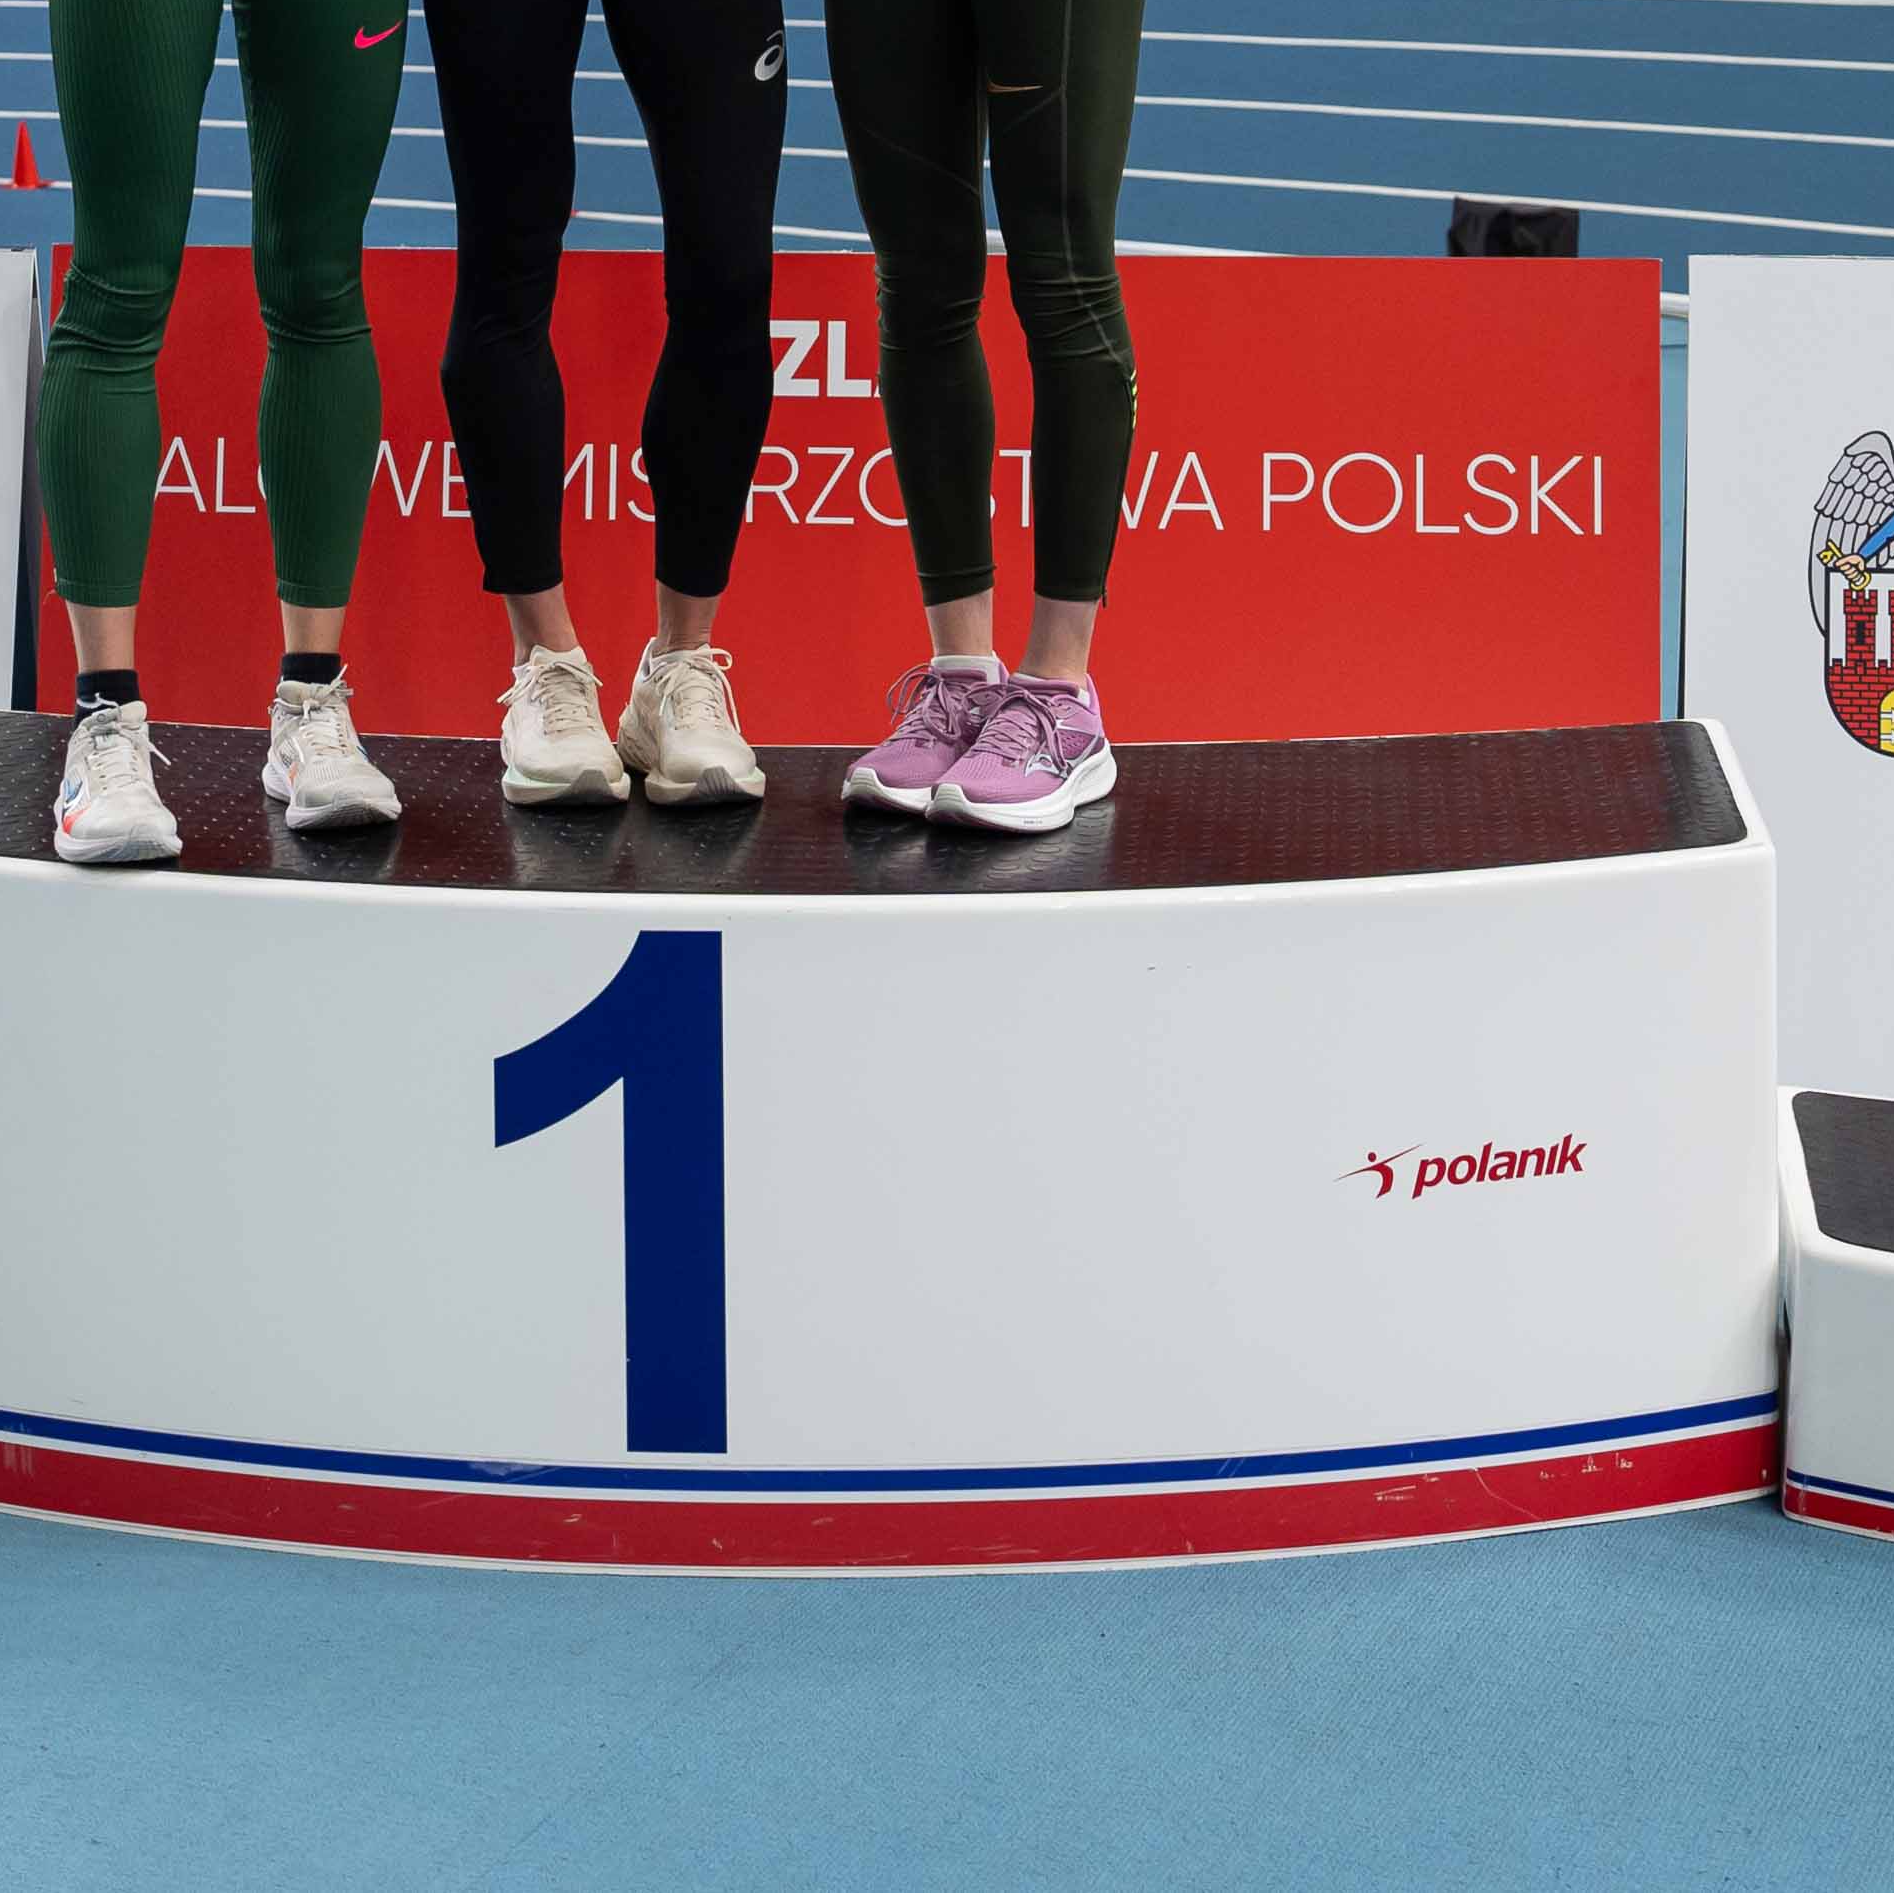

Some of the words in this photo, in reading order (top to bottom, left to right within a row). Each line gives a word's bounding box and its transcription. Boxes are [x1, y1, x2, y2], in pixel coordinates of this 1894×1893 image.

[771, 319, 882, 399] ZL
[153, 436, 472, 518] ALWE
[1261, 451, 1602, 536] POLSKI
[494, 930, 728, 1453] 1
[1411, 1133, 1587, 1200] polanik
